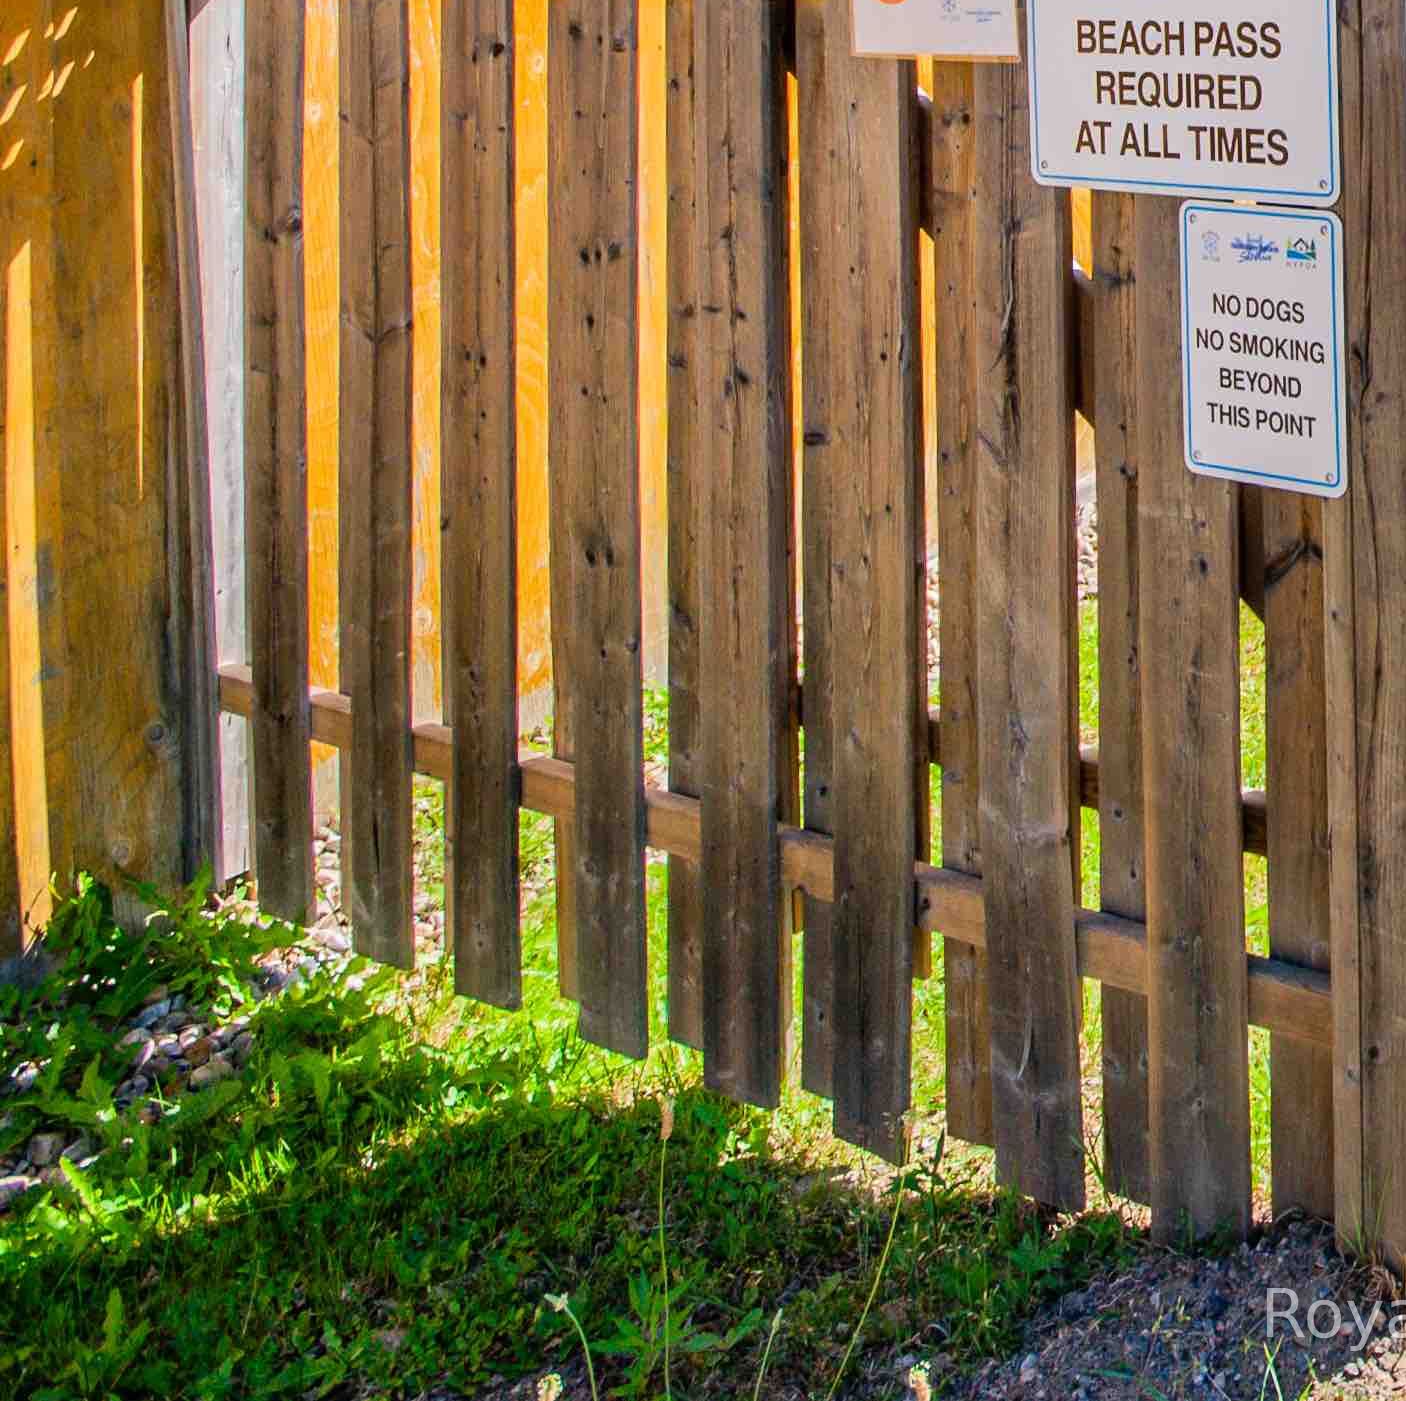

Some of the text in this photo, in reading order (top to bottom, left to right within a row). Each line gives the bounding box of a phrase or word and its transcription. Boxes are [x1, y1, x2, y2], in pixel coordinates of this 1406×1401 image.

[1075, 19, 1282, 59] BEACH PASS
[1095, 70, 1263, 111] REQUIRED
[1075, 120, 1289, 166] AT ALL TIMES
[1212, 293, 1305, 324] NO DOGS
[1196, 327, 1325, 364] NO SMOKING
[1219, 367, 1302, 398] BEYOND
[1207, 402, 1316, 438] THIS POINT
